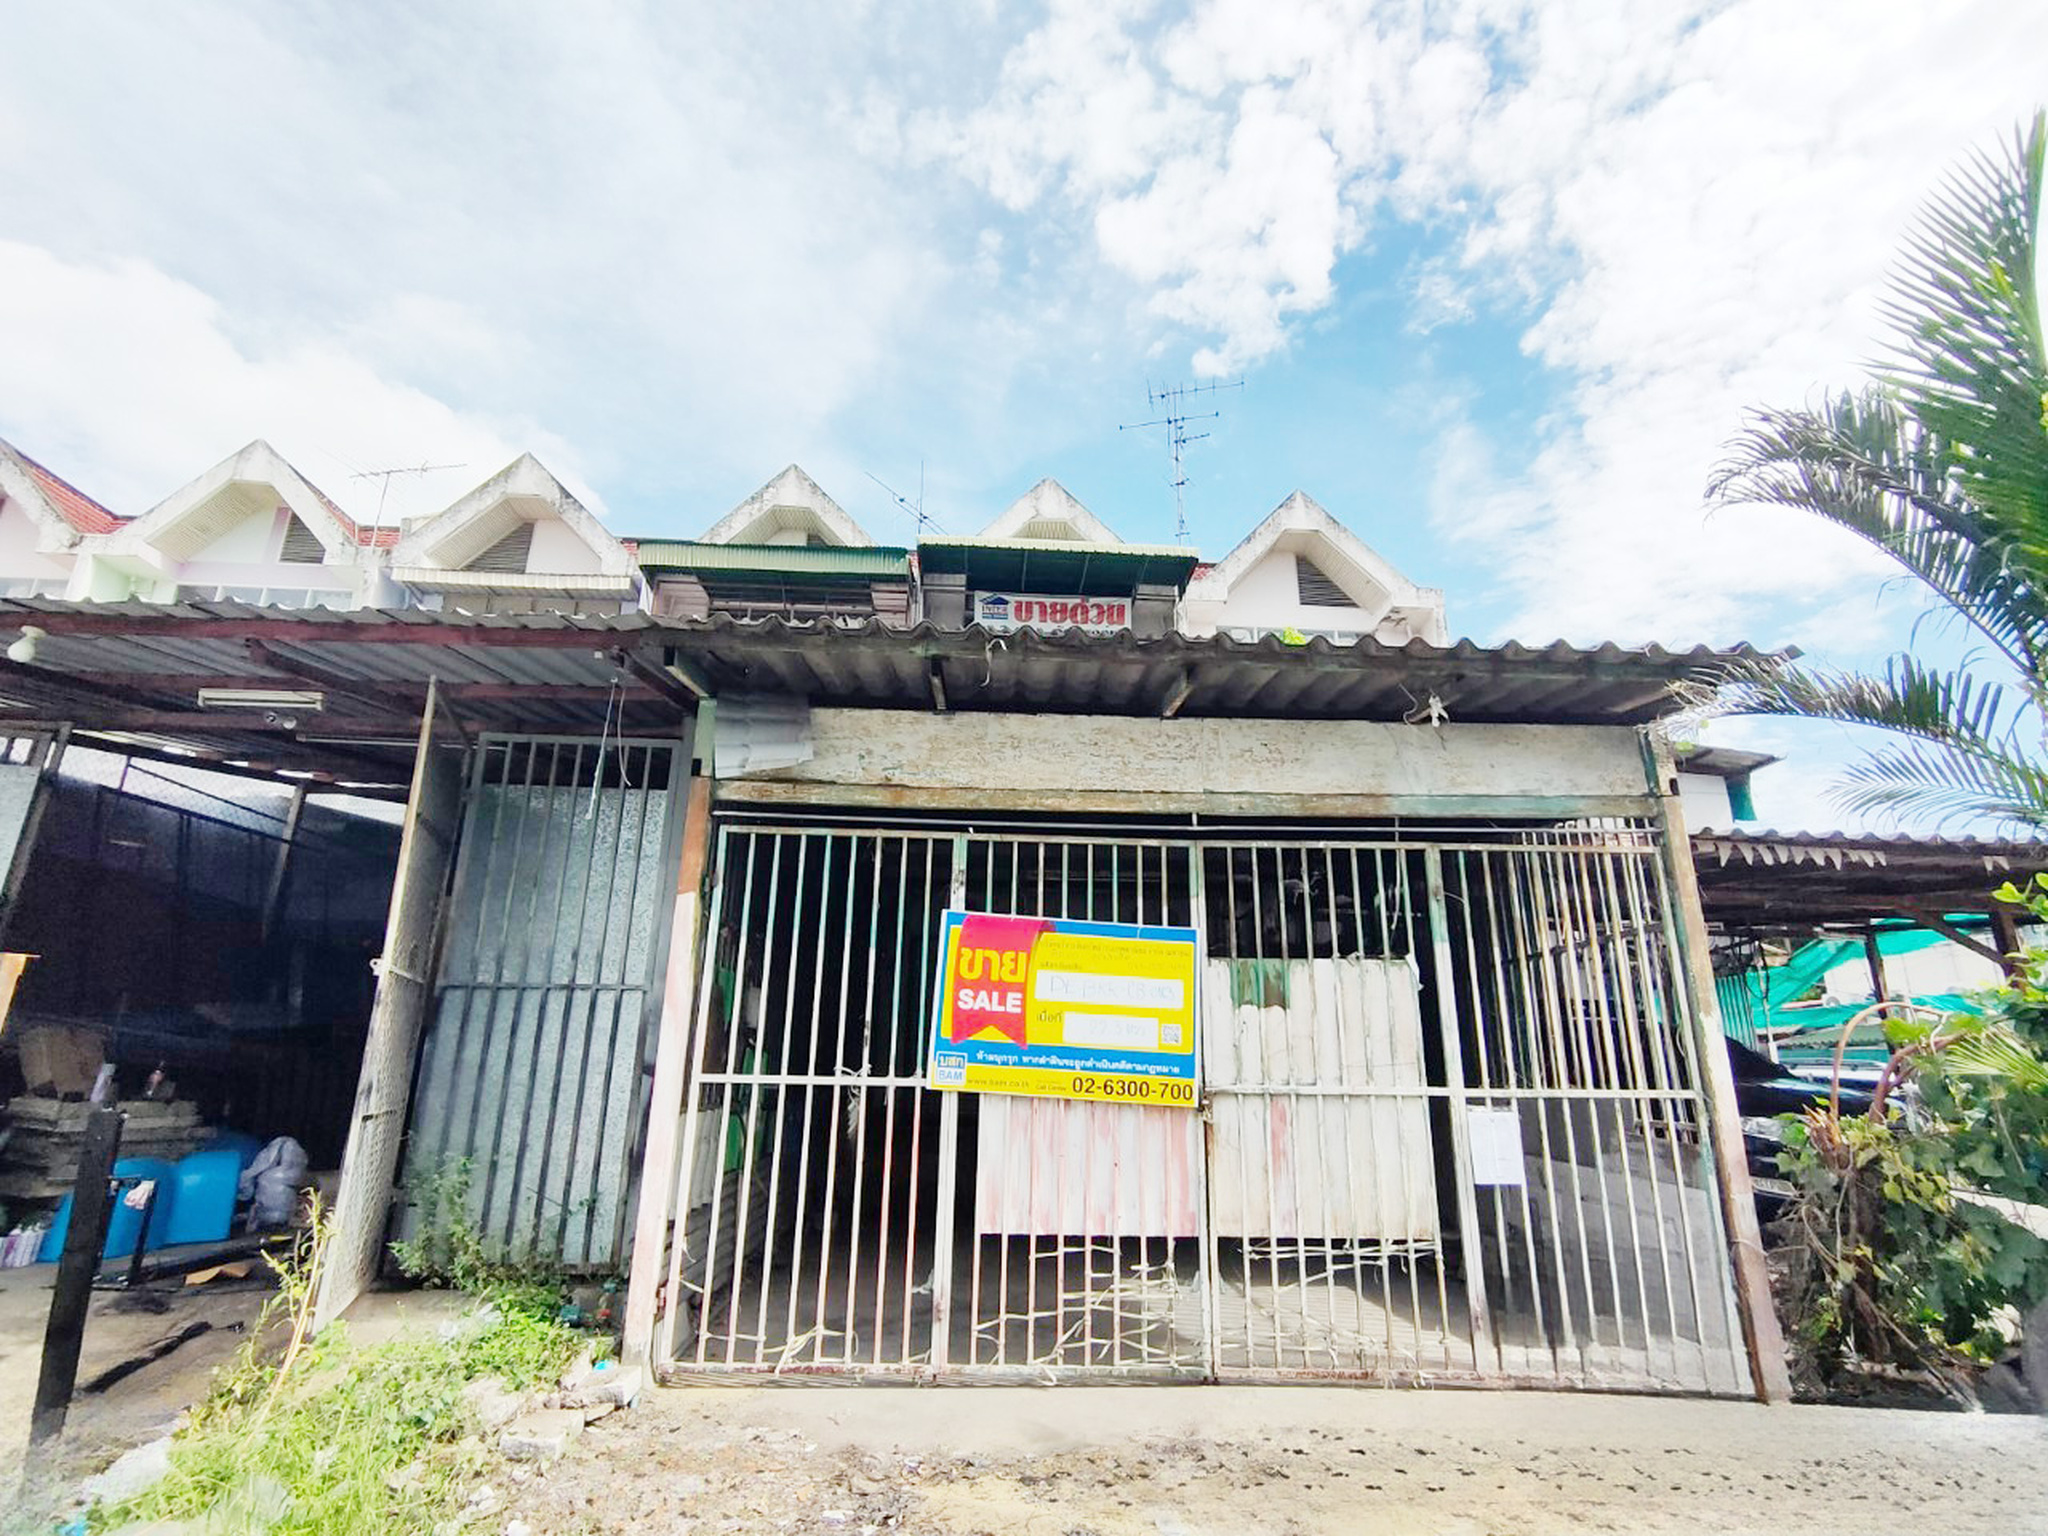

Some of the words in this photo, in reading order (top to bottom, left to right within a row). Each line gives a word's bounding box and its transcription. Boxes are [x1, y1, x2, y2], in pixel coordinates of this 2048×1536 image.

[1014, 596, 1126, 625] ขายด่วน
[960, 947, 1027, 983] ขาย
[958, 988, 1023, 1013] SALE
[939, 1070, 963, 1081] BAM
[1072, 1076, 1194, 1101] 02-6300-700
